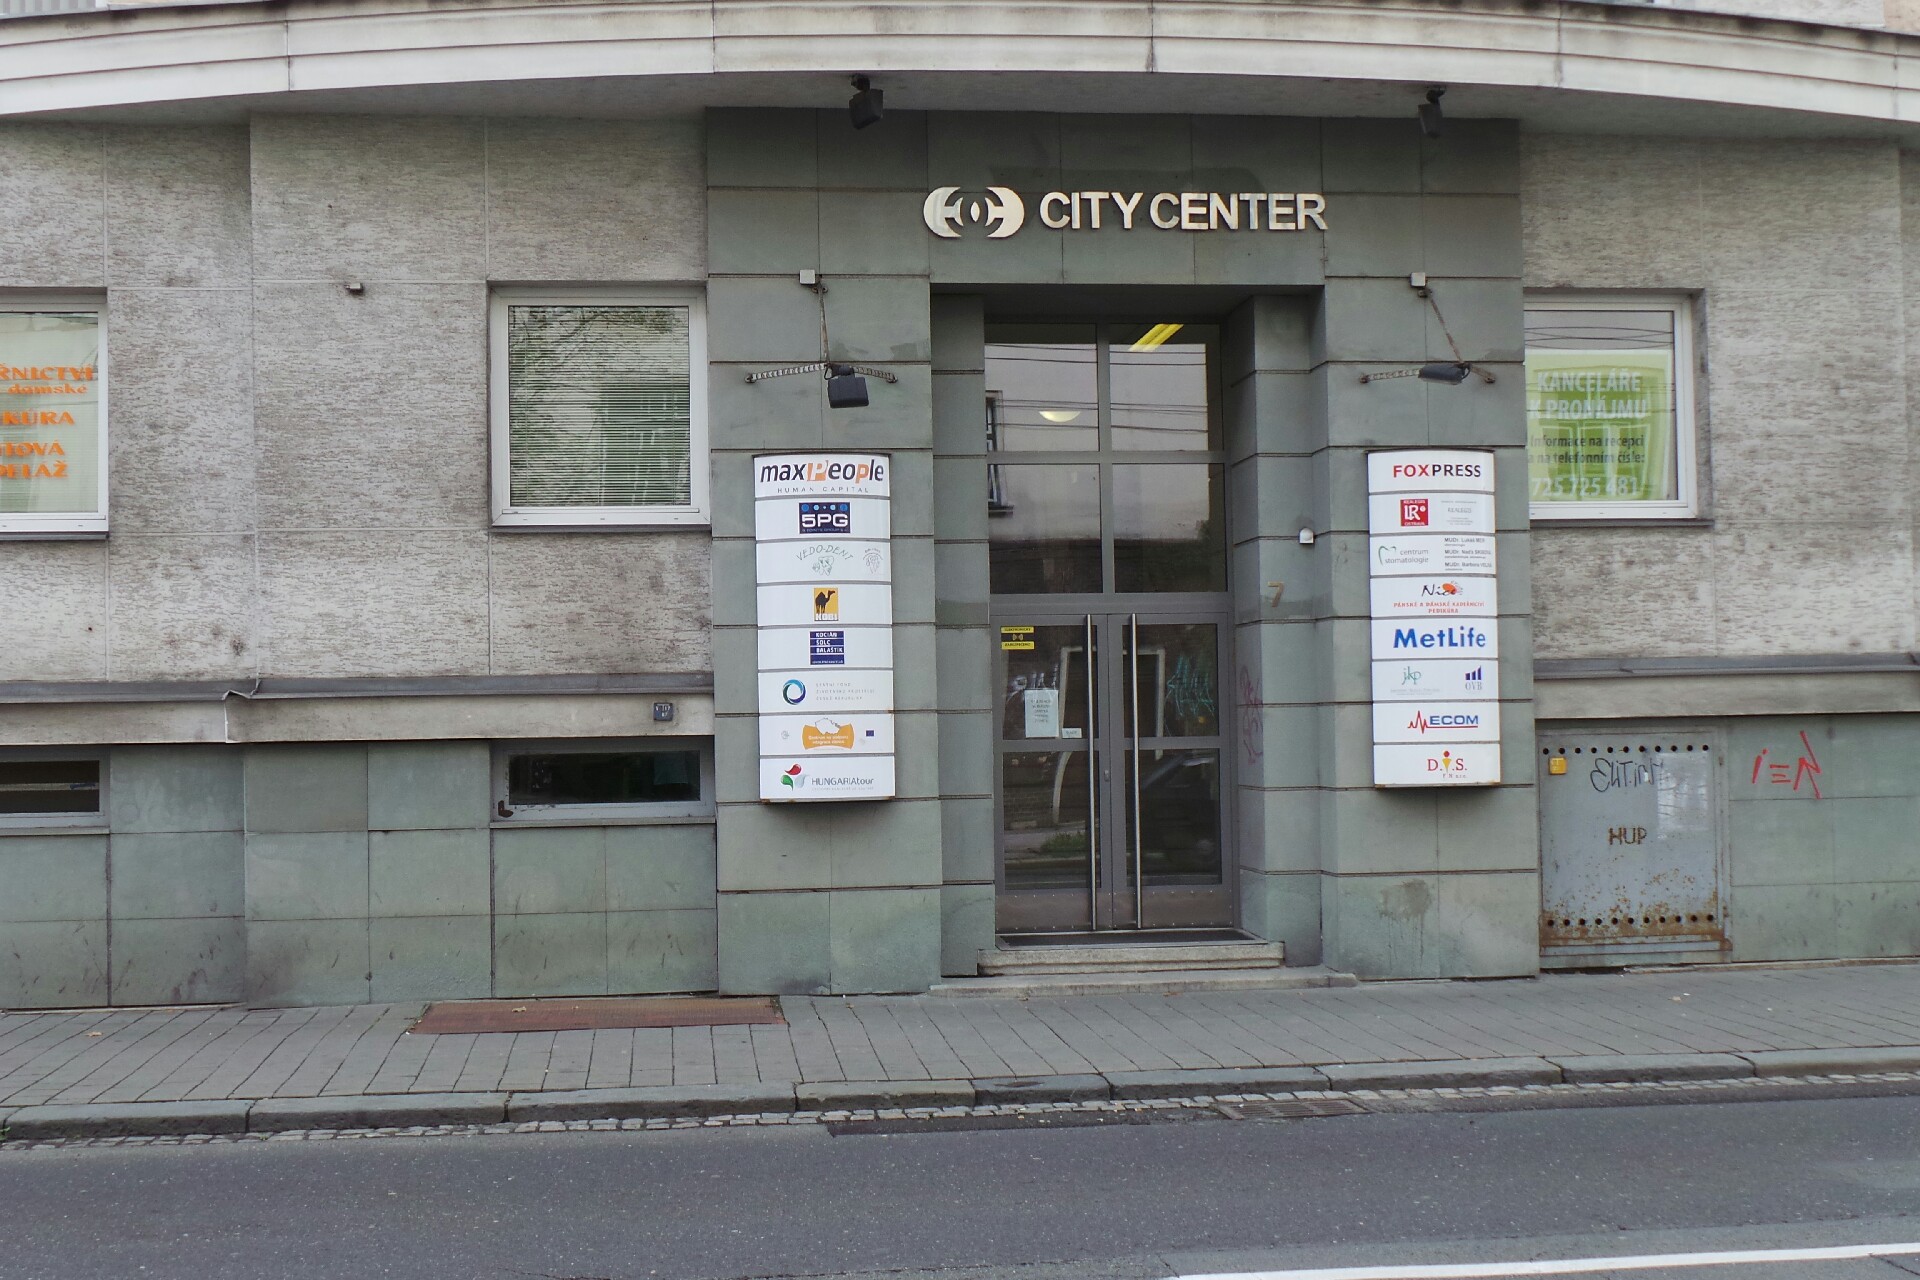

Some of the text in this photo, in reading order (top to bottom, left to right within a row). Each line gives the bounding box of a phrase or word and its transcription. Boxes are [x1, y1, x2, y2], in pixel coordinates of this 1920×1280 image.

[1039, 191, 1329, 231] CITY CENTER
[1537, 368, 1641, 392] KANCELÁŘE
[1527, 395, 1647, 419] K PRONÁJMU
[0, 440, 65, 457] TOVÁ
[1531, 435, 1644, 448] Informace na recepci
[1537, 454, 1550, 463] na
[1553, 452, 1617, 463] telefonním
[760, 459, 884, 484] maxPeople
[1393, 464, 1481, 478] FOXPRESS
[1531, 476, 1638, 497] 725 725 481
[802, 513, 848, 528] 5PG
[796, 544, 855, 562] VEDO-DENT
[1385, 557, 1429, 565] stomatologie
[1267, 581, 1285, 608] 7
[1393, 625, 1486, 648] MetLife
[1430, 715, 1479, 725] ECOM
[811, 777, 874, 786] HUNGARIAtour
[1608, 827, 1647, 845] HUP
